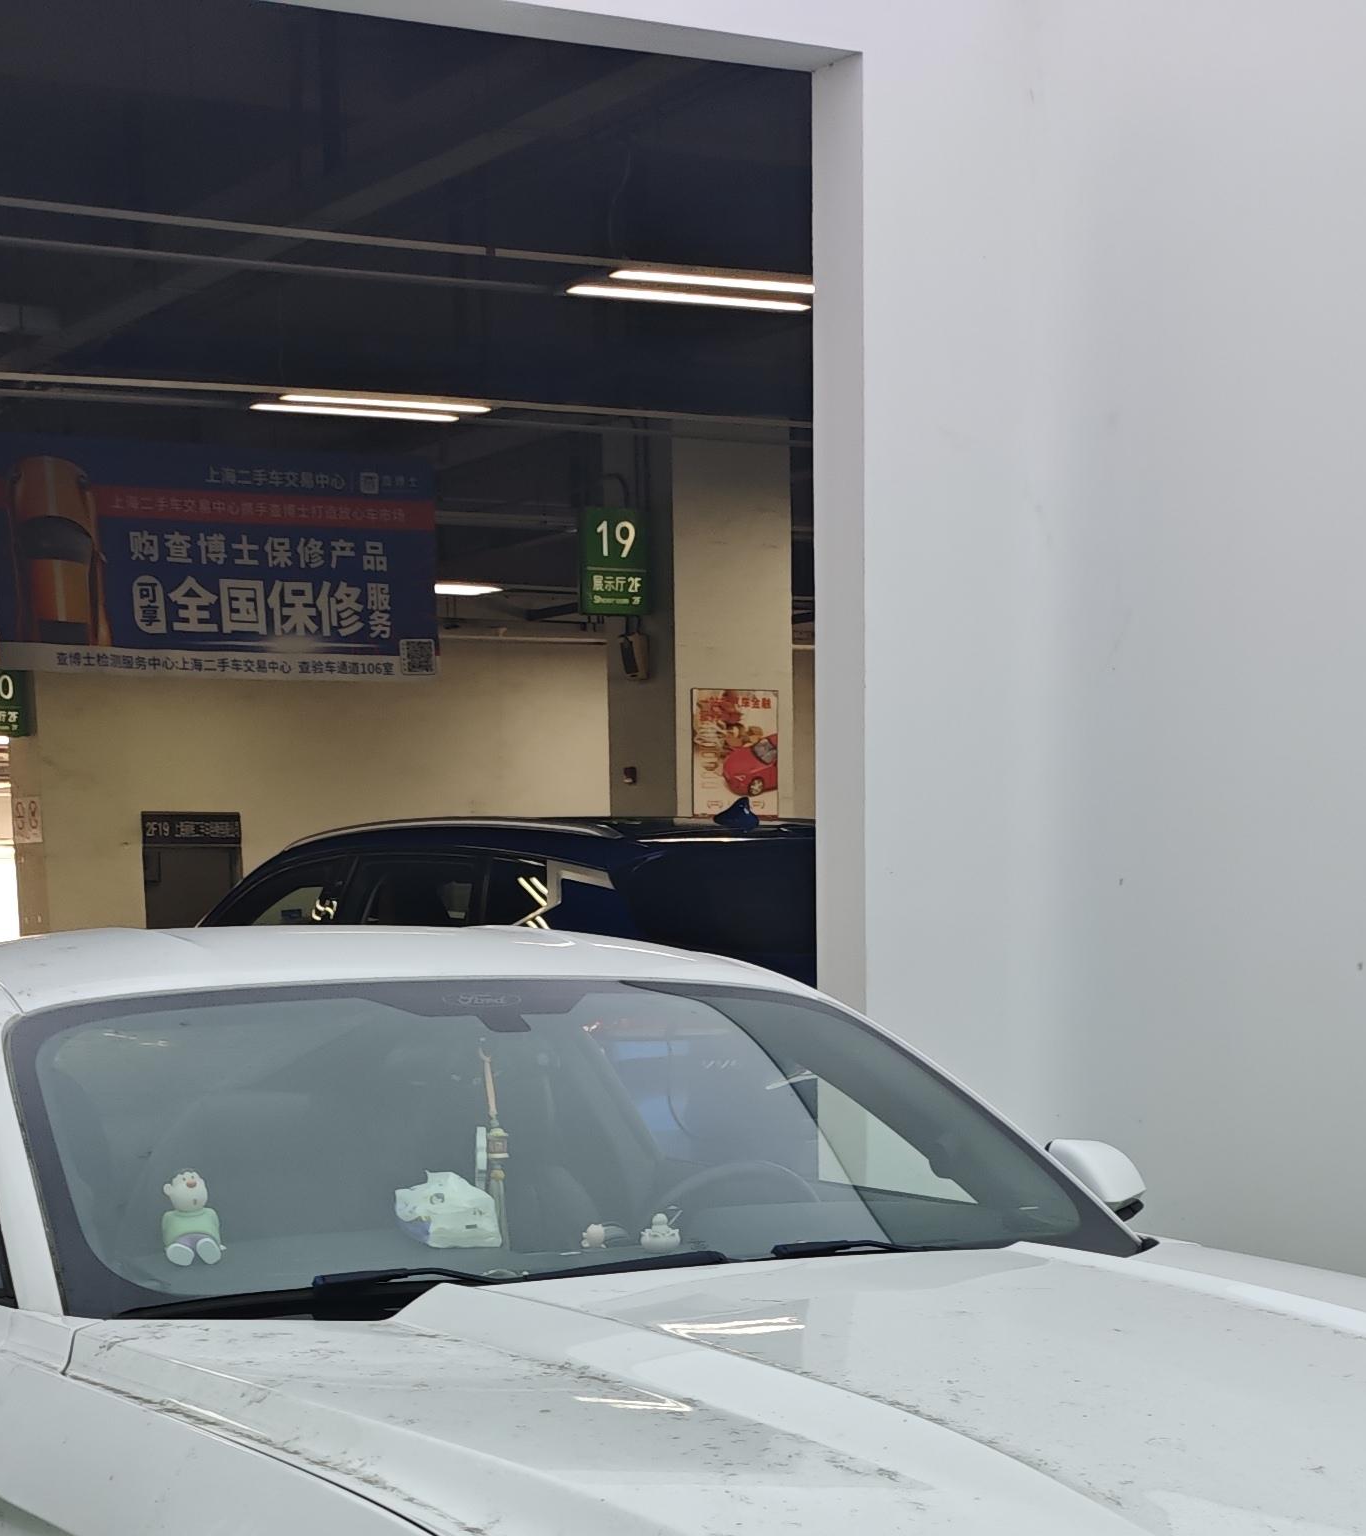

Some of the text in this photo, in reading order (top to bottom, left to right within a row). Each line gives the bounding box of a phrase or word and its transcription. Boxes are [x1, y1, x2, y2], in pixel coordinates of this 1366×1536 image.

[204, 464, 347, 492] 上海二手车交易中心
[128, 530, 389, 573] 购查博士保修产品
[596, 519, 636, 558] 19
[591, 574, 627, 593] 展示厅
[138, 578, 392, 640] 可享 全国保修 服务
[145, 822, 170, 837] 2F19
